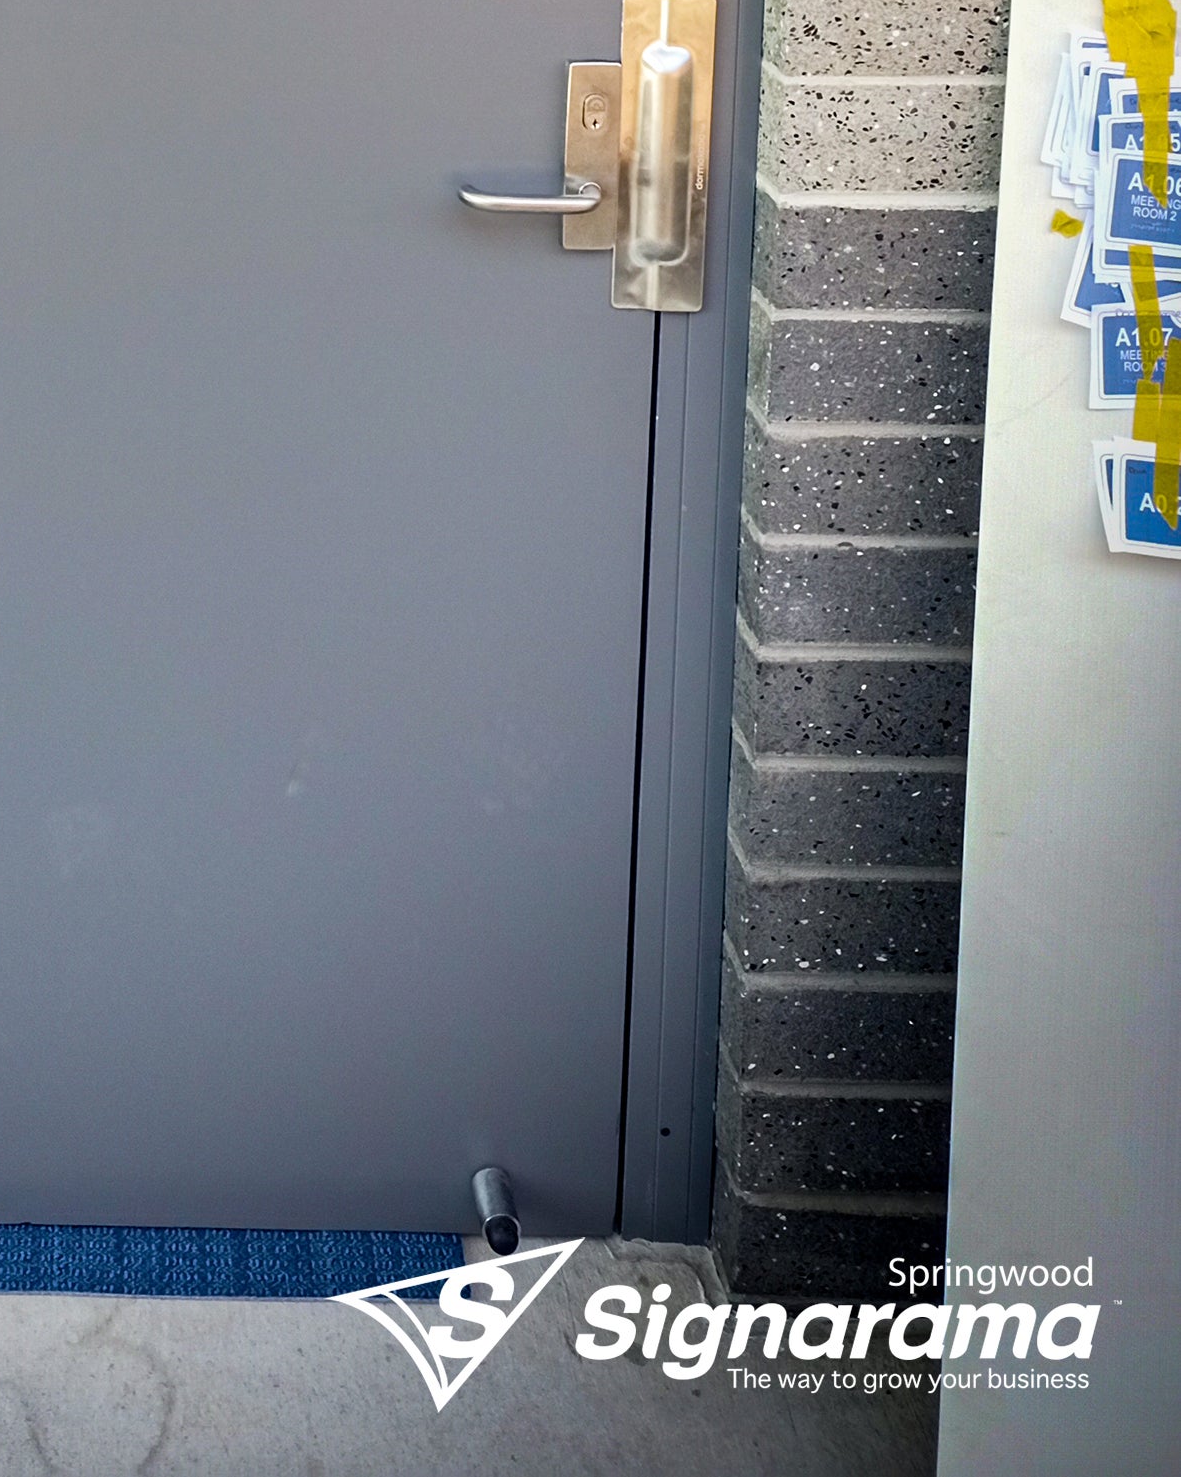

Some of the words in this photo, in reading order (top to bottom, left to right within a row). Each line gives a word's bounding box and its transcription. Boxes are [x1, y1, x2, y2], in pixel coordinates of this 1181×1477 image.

[1131, 194, 1181, 210] MEETING
[1133, 206, 1168, 220] ROOM
[1170, 210, 1177, 221] 2
[1115, 327, 1173, 347] A1.07
[1124, 361, 1159, 372] ROOM
